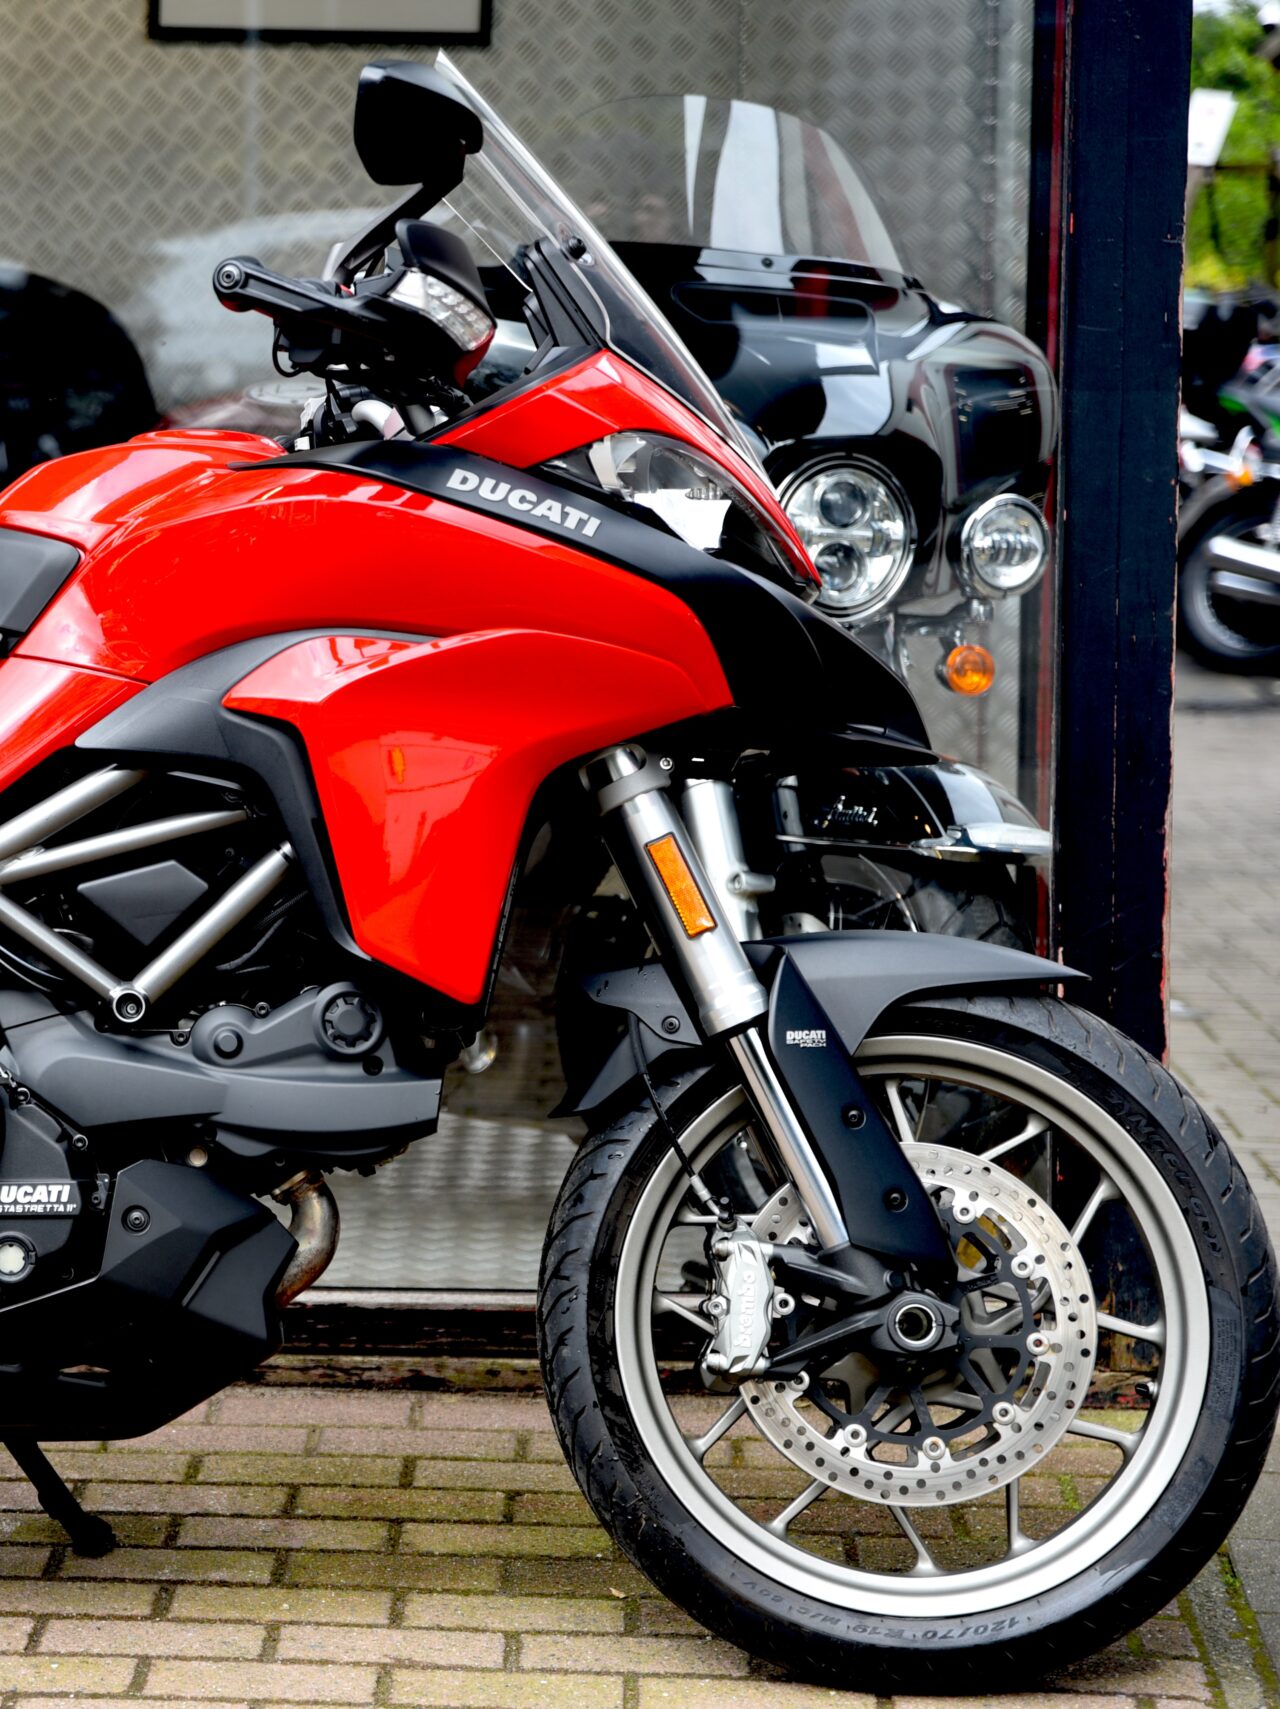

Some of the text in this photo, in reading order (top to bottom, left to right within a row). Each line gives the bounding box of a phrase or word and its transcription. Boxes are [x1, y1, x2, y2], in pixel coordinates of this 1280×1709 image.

[446, 468, 601, 537] DUCATI
[786, 1030, 826, 1040] DUCATI
[733, 1270, 758, 1348] brembo
[918, 1616, 1019, 1641] 120/70
